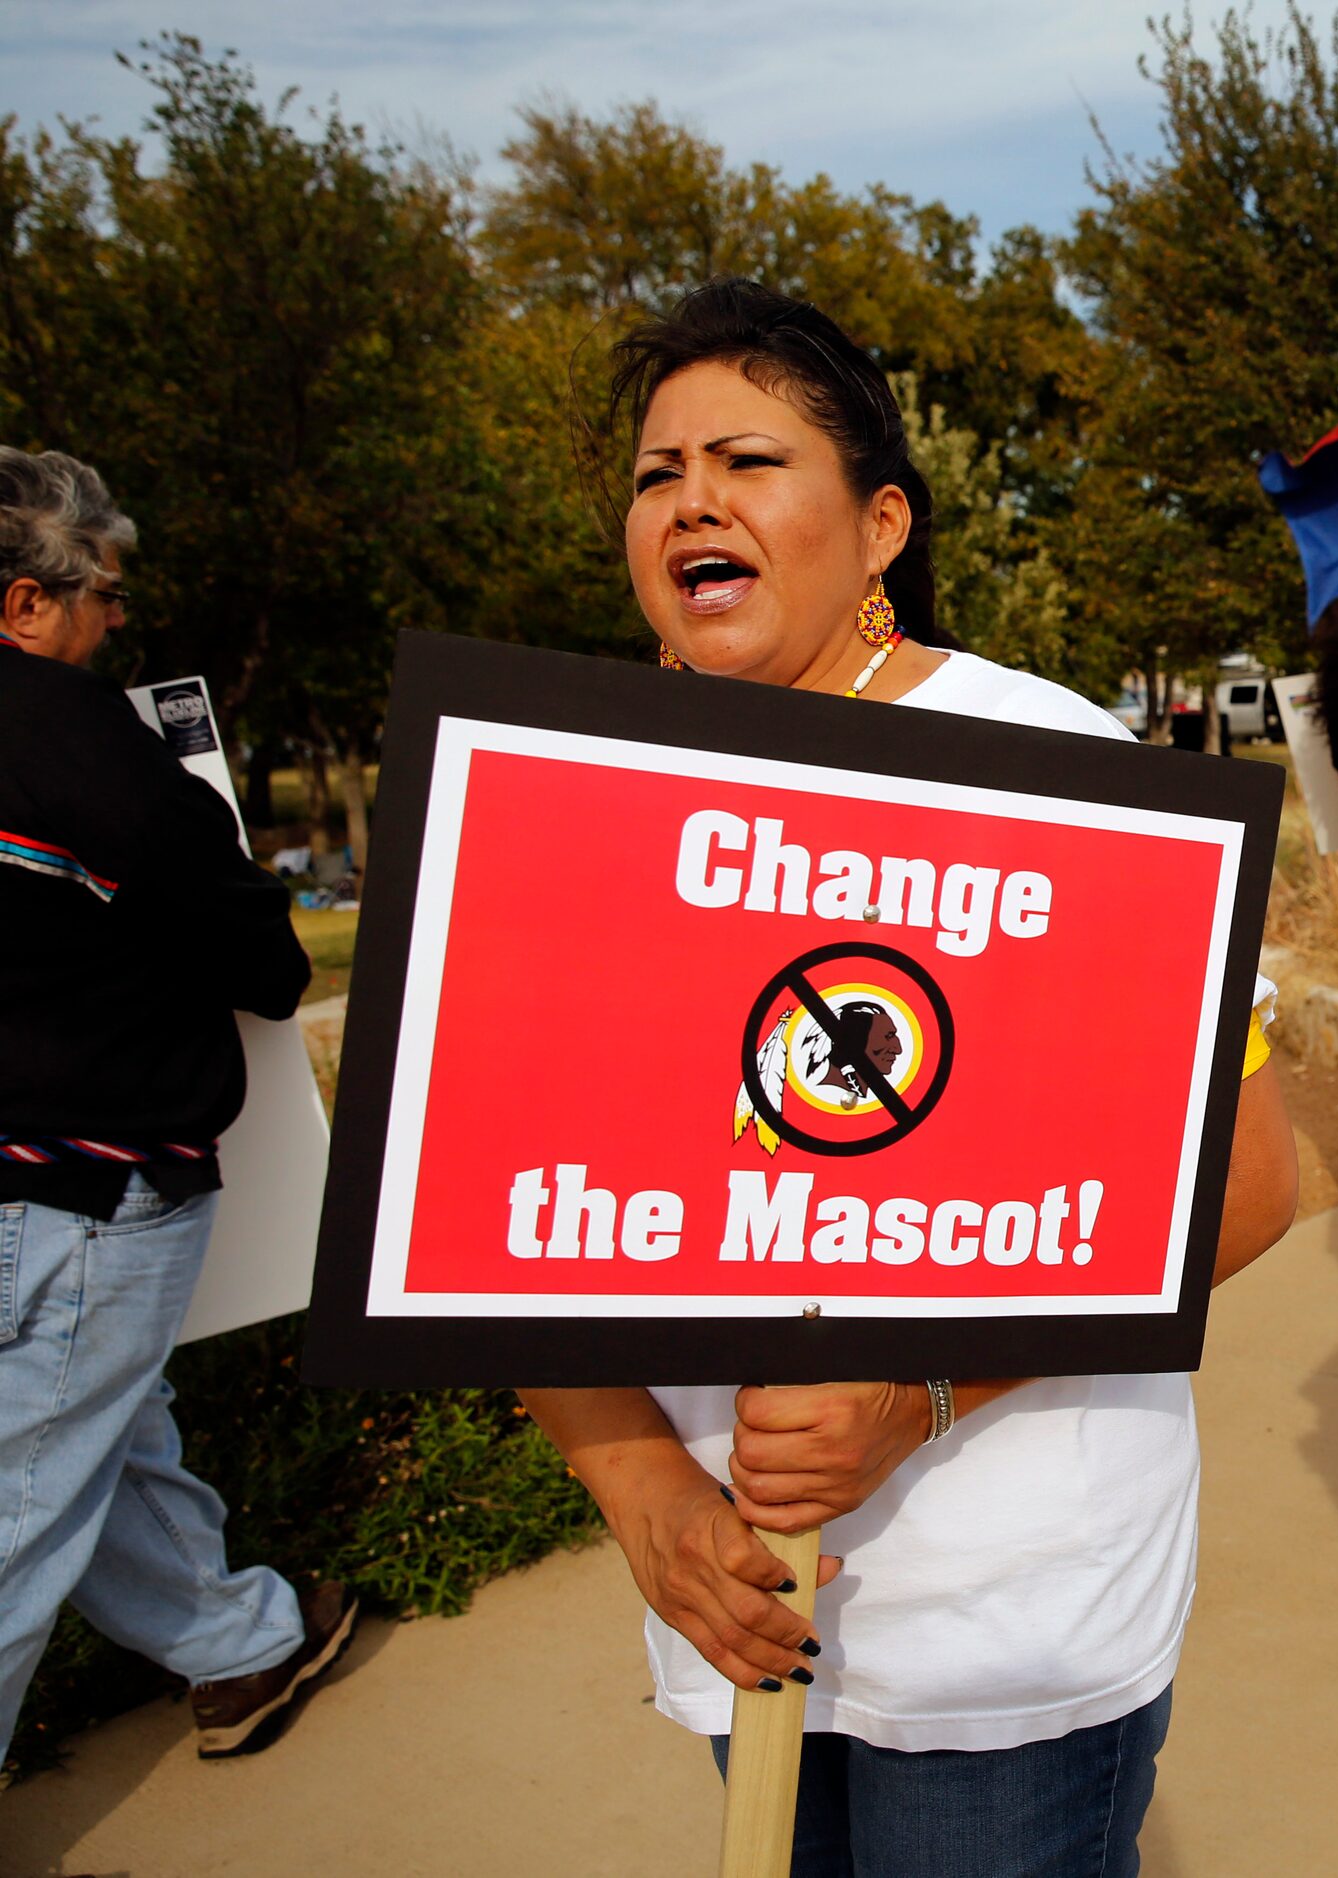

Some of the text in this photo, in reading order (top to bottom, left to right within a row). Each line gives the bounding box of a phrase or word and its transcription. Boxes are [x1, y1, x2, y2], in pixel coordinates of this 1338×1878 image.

[675, 809, 1053, 957] Change
[506, 1163, 1105, 1266] the Mascot!
